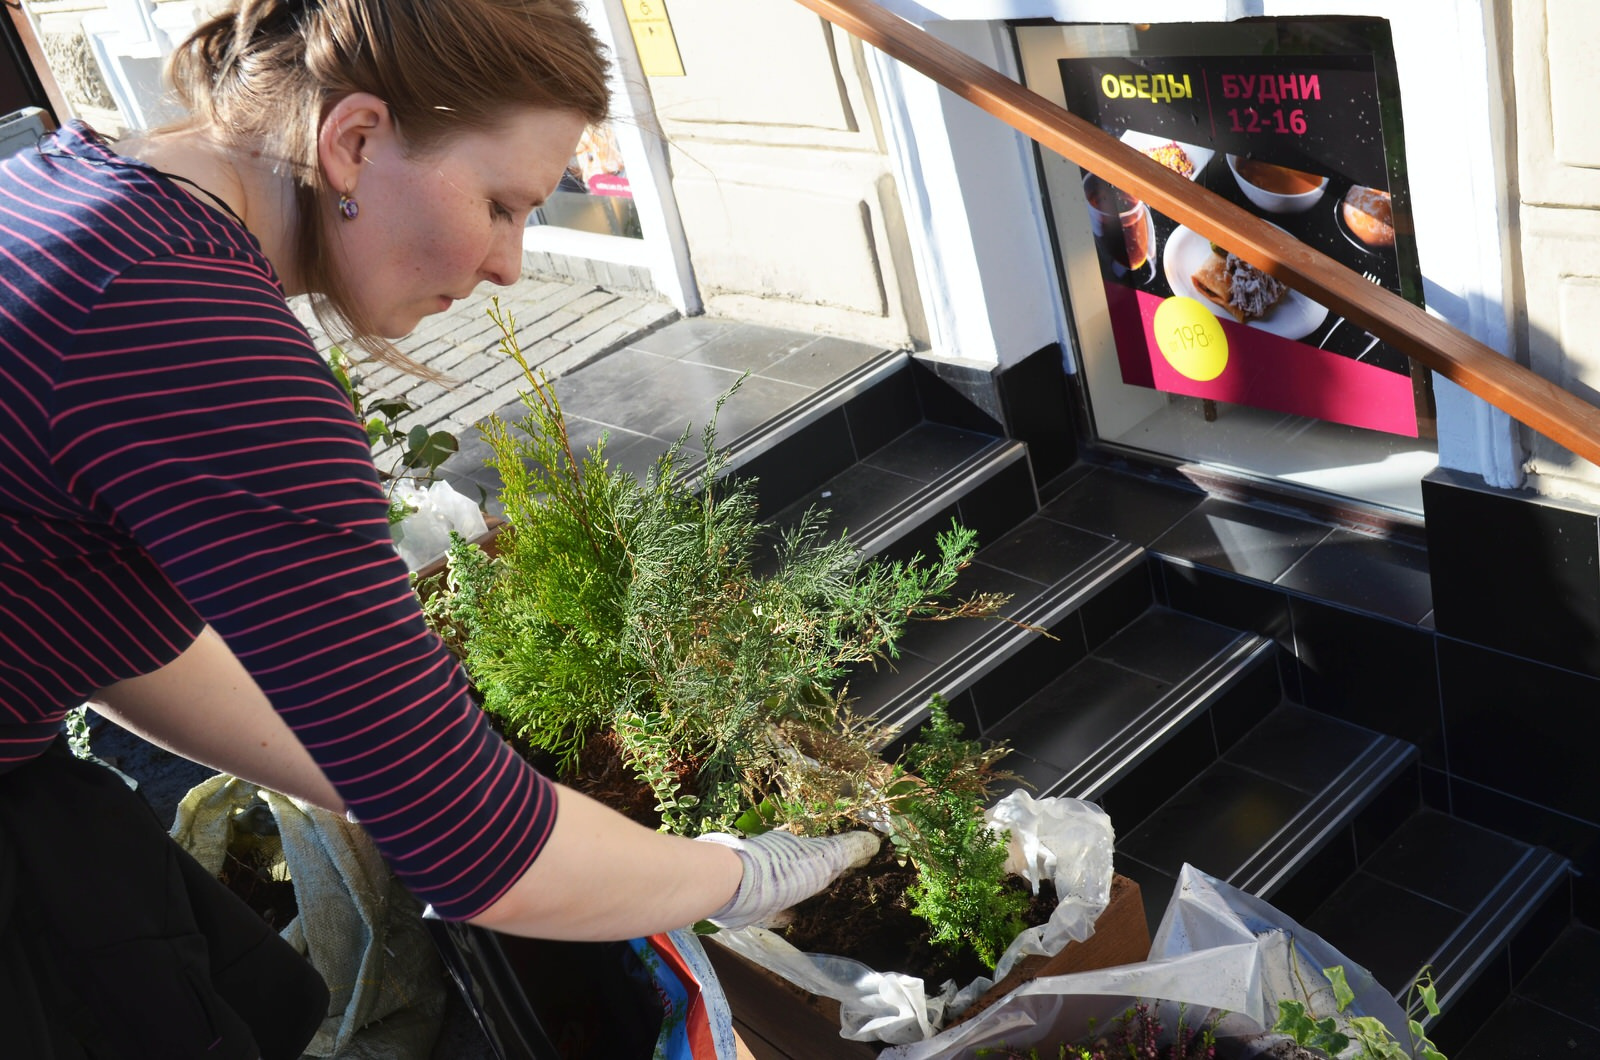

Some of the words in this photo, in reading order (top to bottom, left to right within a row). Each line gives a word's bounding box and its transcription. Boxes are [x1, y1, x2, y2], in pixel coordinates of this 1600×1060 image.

[1101, 74, 1192, 103] ОБЕДЫ
[1221, 74, 1321, 104] БУДНИ
[1227, 108, 1307, 135] 12-16
